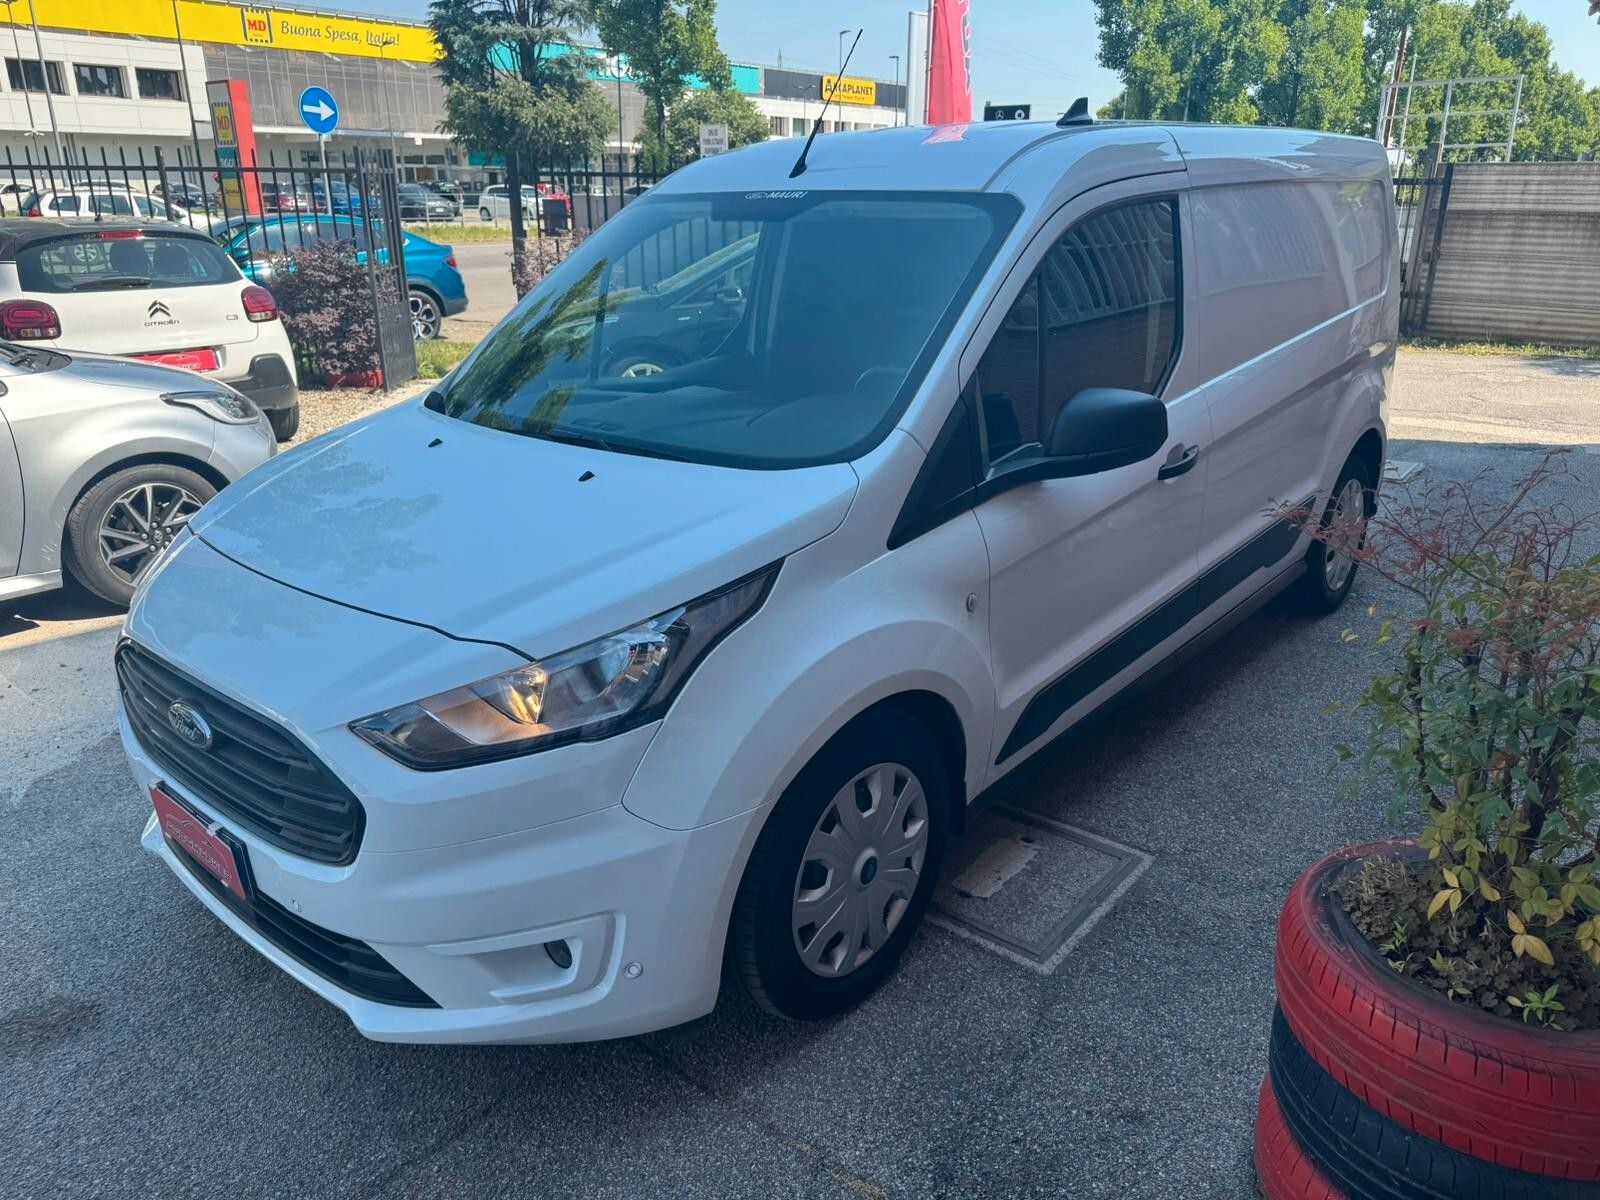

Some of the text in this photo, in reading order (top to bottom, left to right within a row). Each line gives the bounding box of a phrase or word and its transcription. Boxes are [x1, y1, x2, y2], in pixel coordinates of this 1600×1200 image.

[247, 19, 267, 32] MD
[281, 20, 400, 46] Buona Spesa, Italia!
[215, 115, 230, 130] MD
[173, 713, 200, 742] Ford
